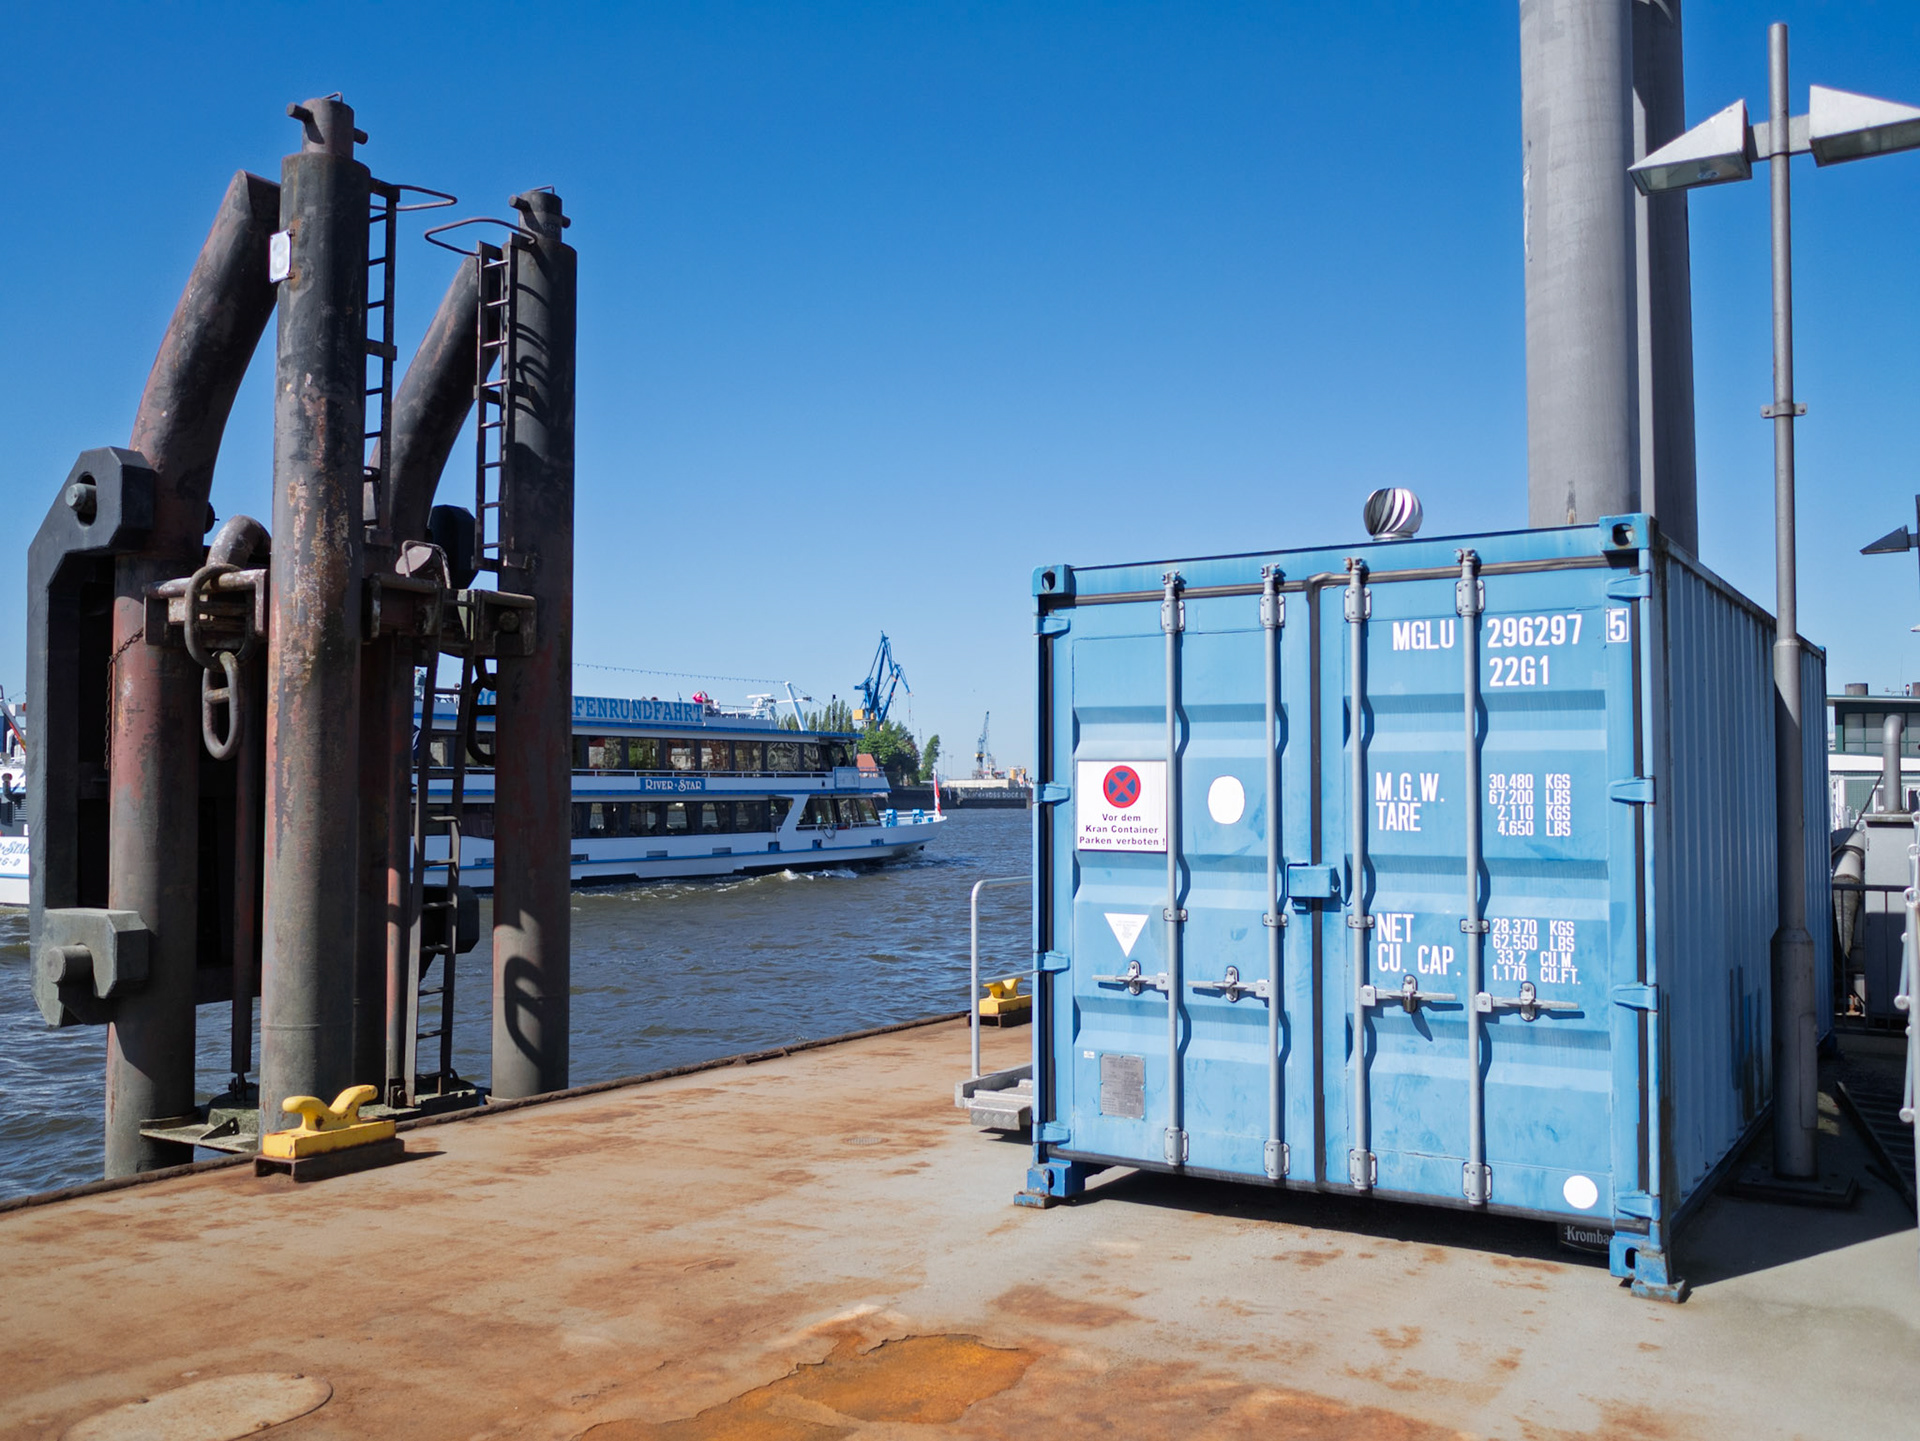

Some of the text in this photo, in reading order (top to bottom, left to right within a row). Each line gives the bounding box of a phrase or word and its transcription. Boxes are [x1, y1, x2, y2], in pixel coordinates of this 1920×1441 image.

[1393, 610, 1626, 650] MGLU 296297 5
[1490, 656, 1548, 686] 22G1
[572, 697, 703, 722] FENRUNDFAHRT
[1375, 772, 1445, 803] M.G.W.
[1546, 774, 1570, 789] KGS
[1546, 790, 1571, 805] LBS
[1121, 814, 1141, 822] dem
[1376, 802, 1421, 831] TARE
[1546, 806, 1571, 820] KGS
[1085, 825, 1159, 834] Kran Container
[1546, 821, 1571, 836] LBS
[1079, 836, 1112, 845] Parken
[1116, 838, 1159, 846] verboten
[1377, 912, 1415, 943] NET
[1550, 920, 1574, 936] KGS
[1549, 937, 1575, 952] LBS
[1377, 943, 1462, 977] CU. CAP.
[1497, 950, 1527, 966] 33.2
[1566, 1225, 1612, 1245] Kromba
